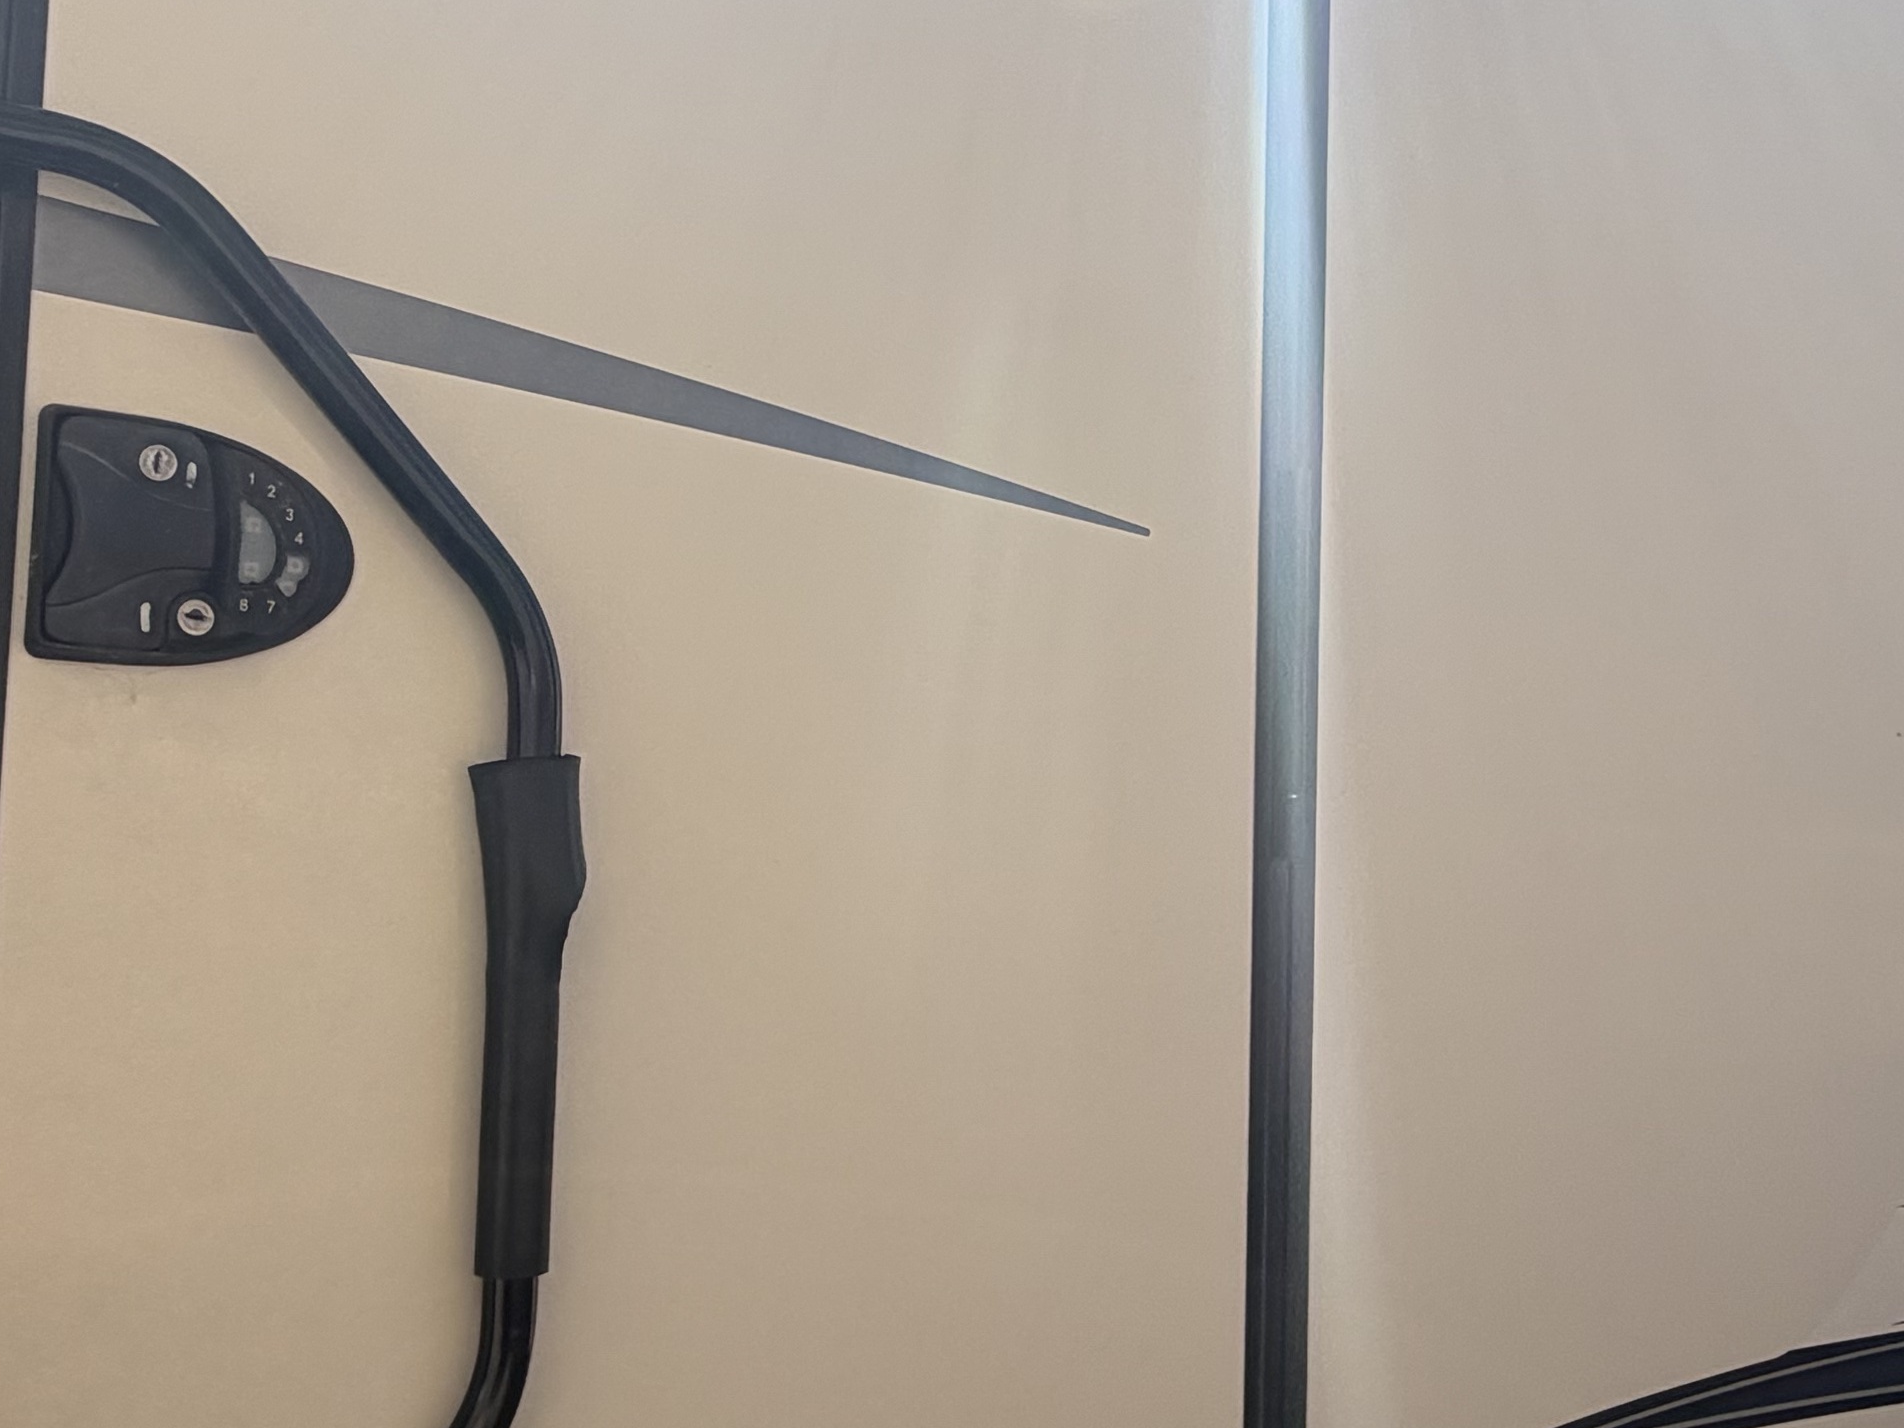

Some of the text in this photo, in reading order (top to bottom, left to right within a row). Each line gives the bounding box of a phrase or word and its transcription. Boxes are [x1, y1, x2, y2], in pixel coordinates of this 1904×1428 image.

[248, 471, 305, 546] 1 2 3 4
[238, 598, 277, 615] 8 7
